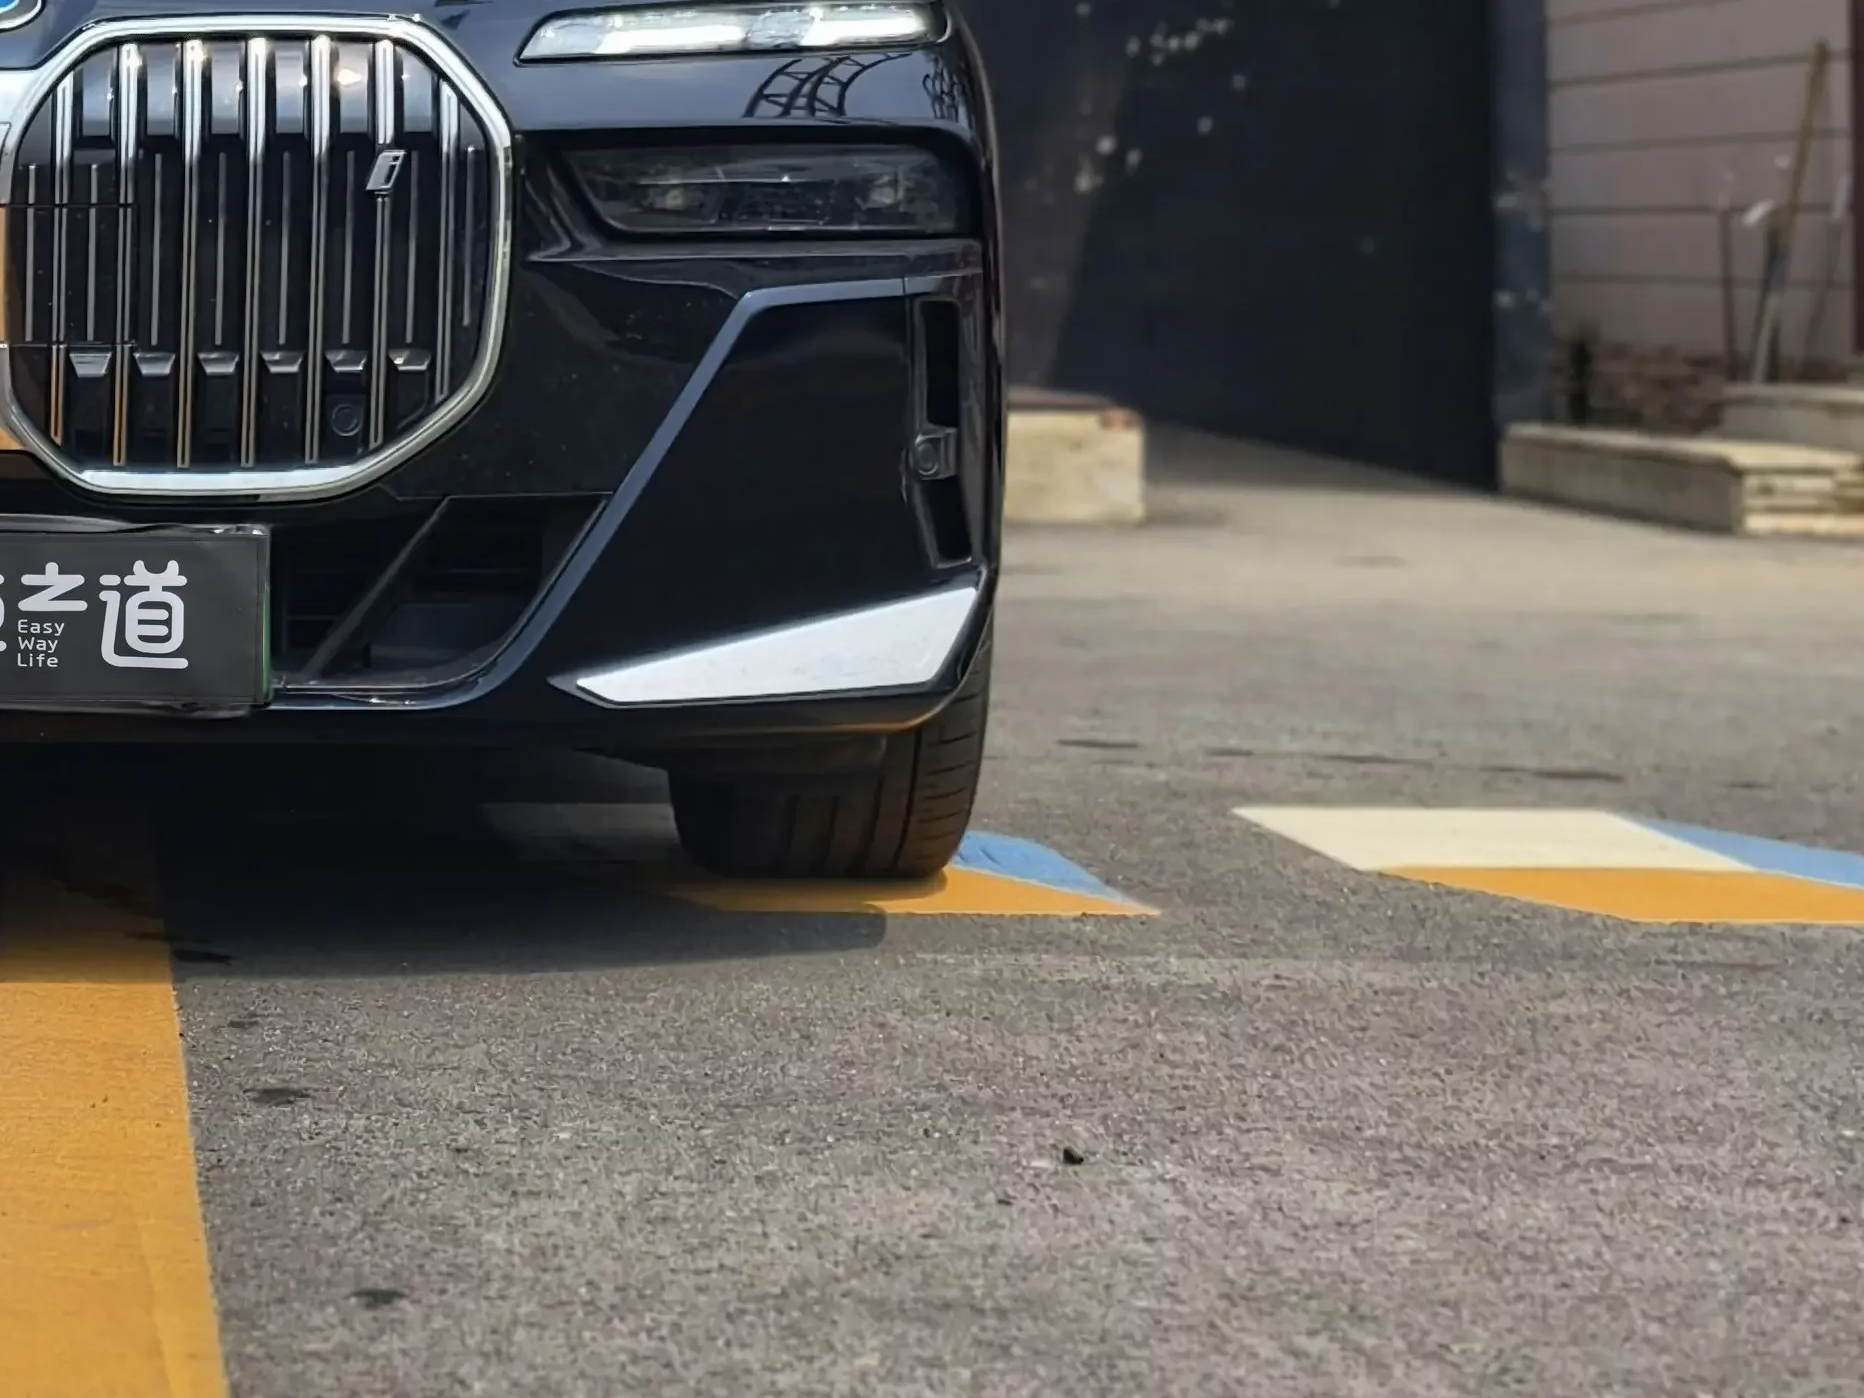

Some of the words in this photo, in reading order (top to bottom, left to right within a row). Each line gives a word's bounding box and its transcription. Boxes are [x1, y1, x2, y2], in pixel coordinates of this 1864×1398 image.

[17, 618, 65, 637] Easy
[17, 636, 58, 653] Way
[17, 652, 59, 668] Life
